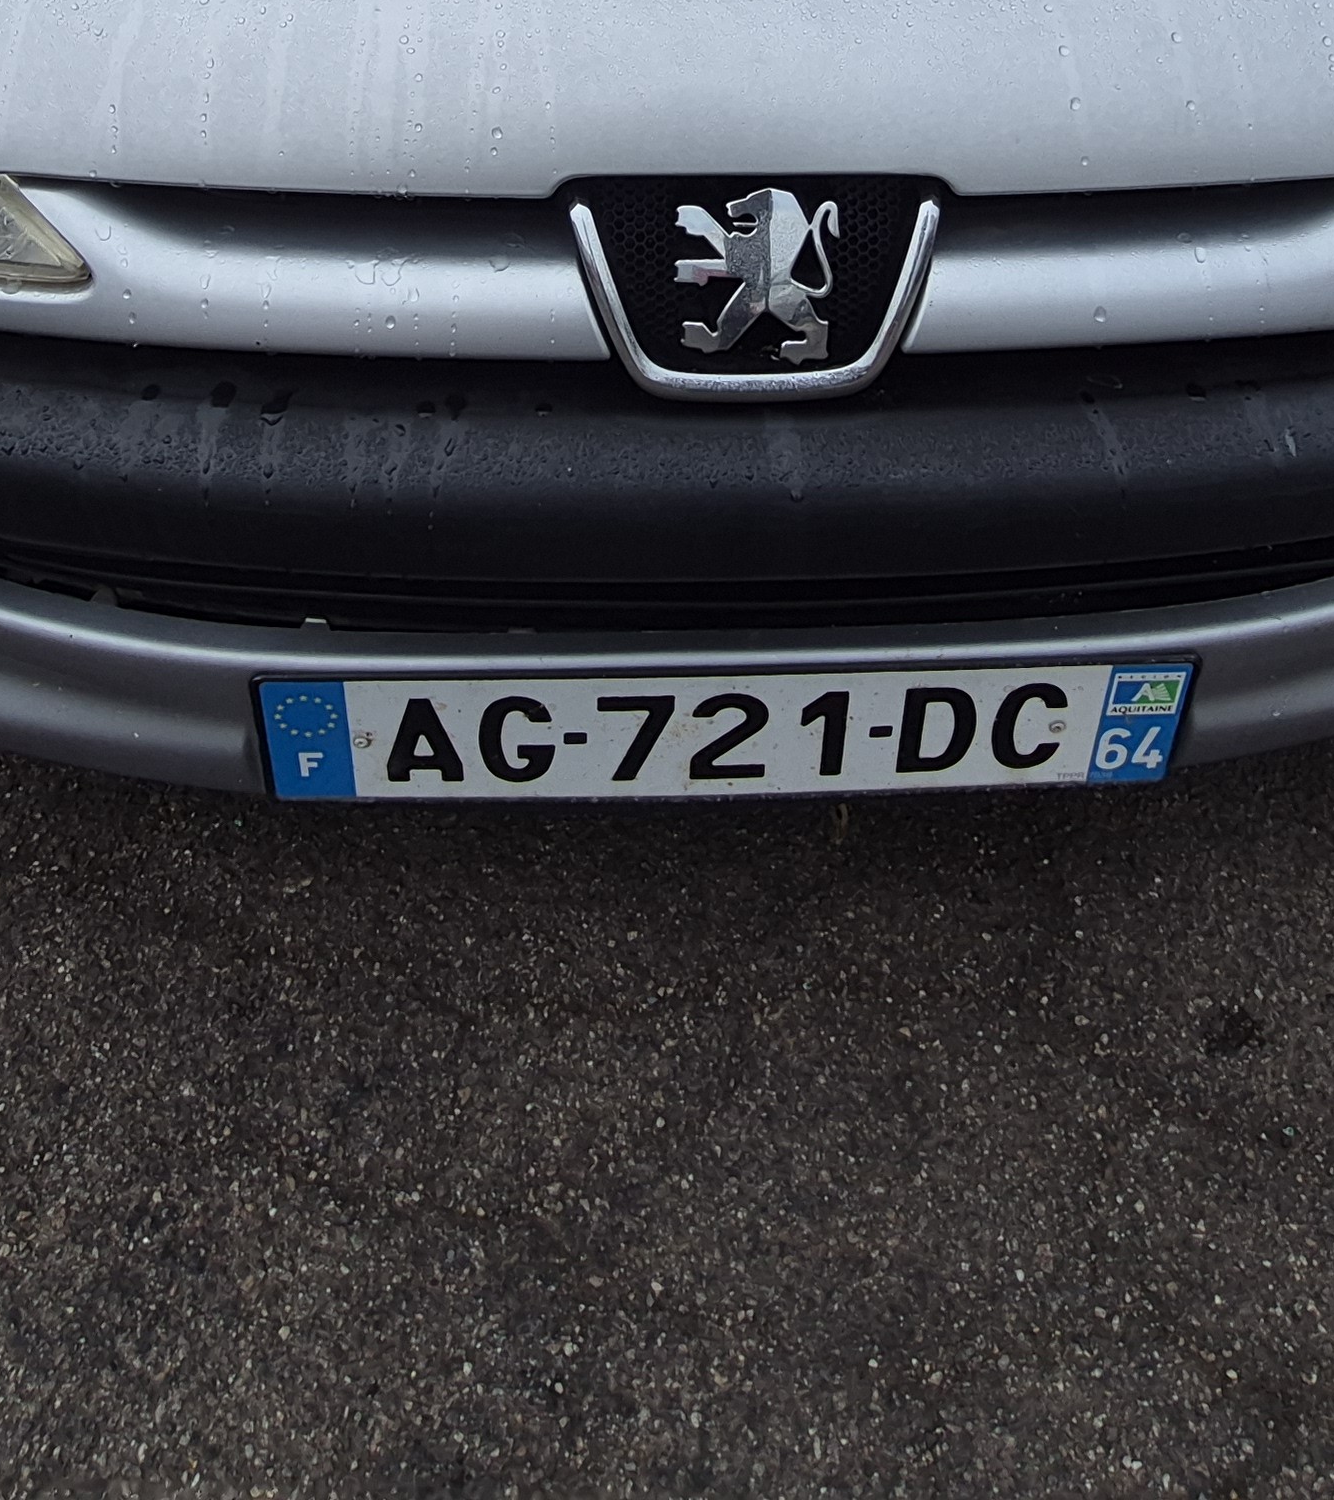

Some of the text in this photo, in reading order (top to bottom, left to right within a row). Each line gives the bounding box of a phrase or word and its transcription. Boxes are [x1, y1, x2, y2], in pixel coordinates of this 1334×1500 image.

[1109, 704, 1174, 715] AQUITAINE
[386, 682, 1068, 783] AG-721-DC
[1095, 726, 1164, 770] 64
[298, 752, 325, 778] F
